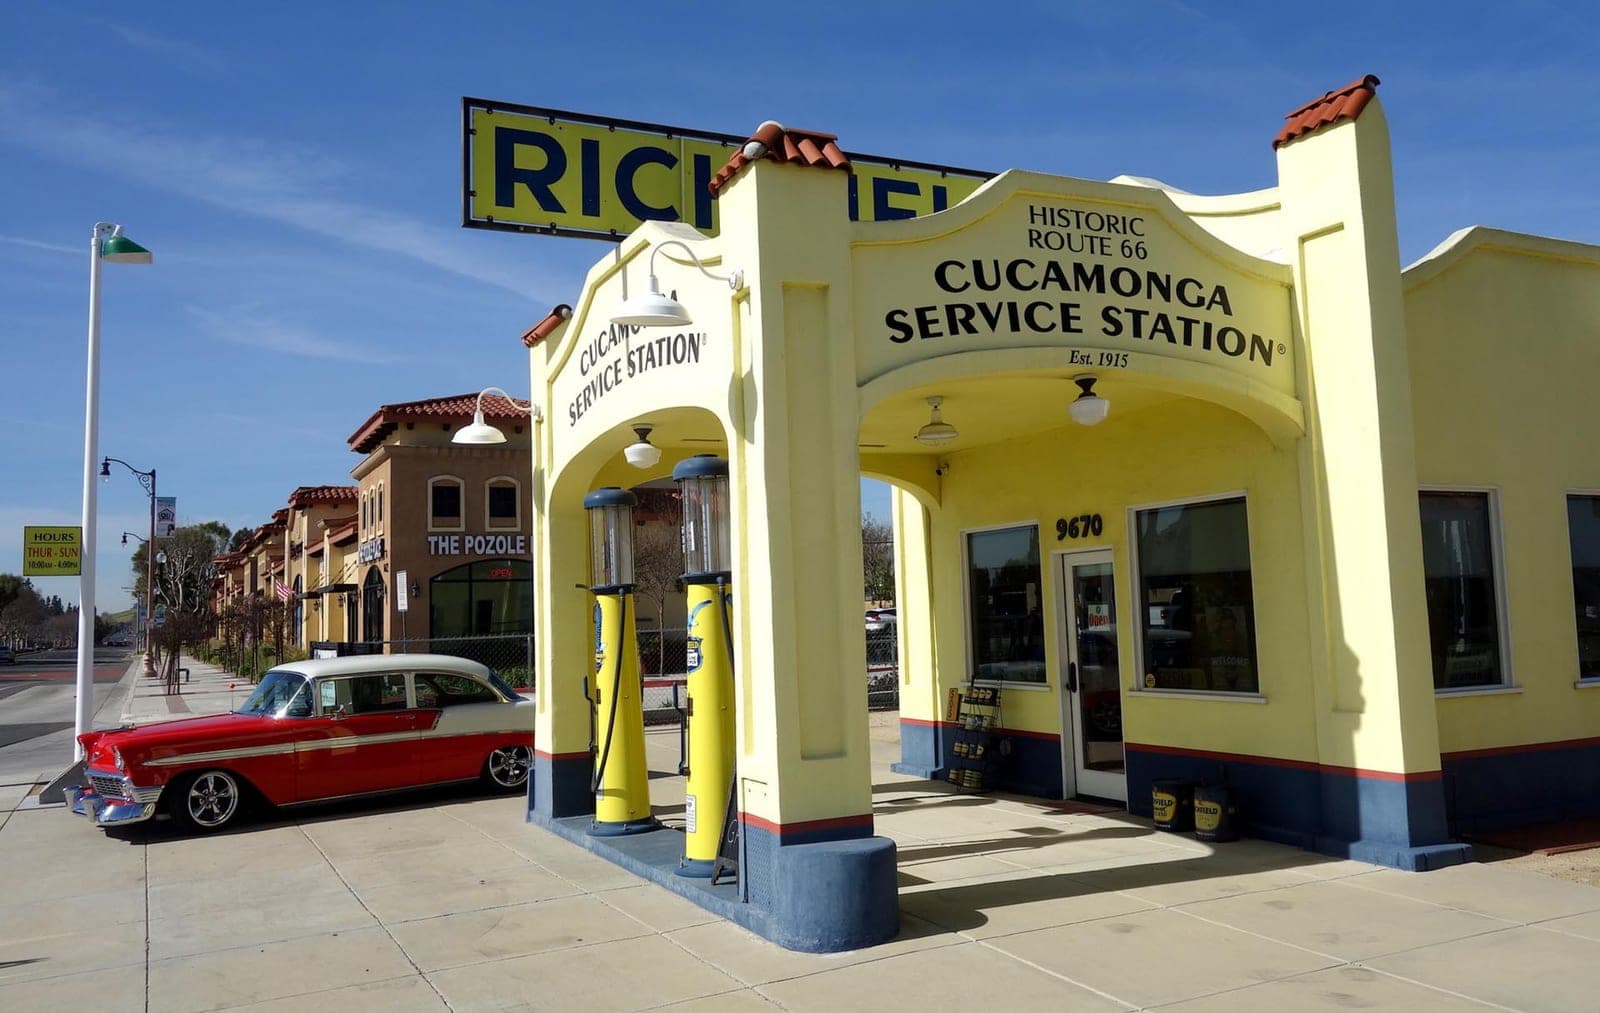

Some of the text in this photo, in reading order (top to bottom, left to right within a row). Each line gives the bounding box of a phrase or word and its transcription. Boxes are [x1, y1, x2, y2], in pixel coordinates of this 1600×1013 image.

[1029, 205, 1145, 237] HISTORIC
[1028, 229, 1148, 260] ROUTE 66
[934, 258, 1233, 316] CUCAMONGA
[885, 301, 1083, 344] SERVICE
[1069, 350, 1129, 368] Est. 1915
[569, 358, 622, 427] SERVICE
[34, 532, 74, 542] HOURS
[1056, 513, 1103, 541] 9670
[27, 547, 53, 558] THUR
[60, 547, 78, 558] SUN
[428, 535, 460, 555] THE
[465, 535, 526, 555] POZOLE
[490, 567, 513, 578] OPEN
